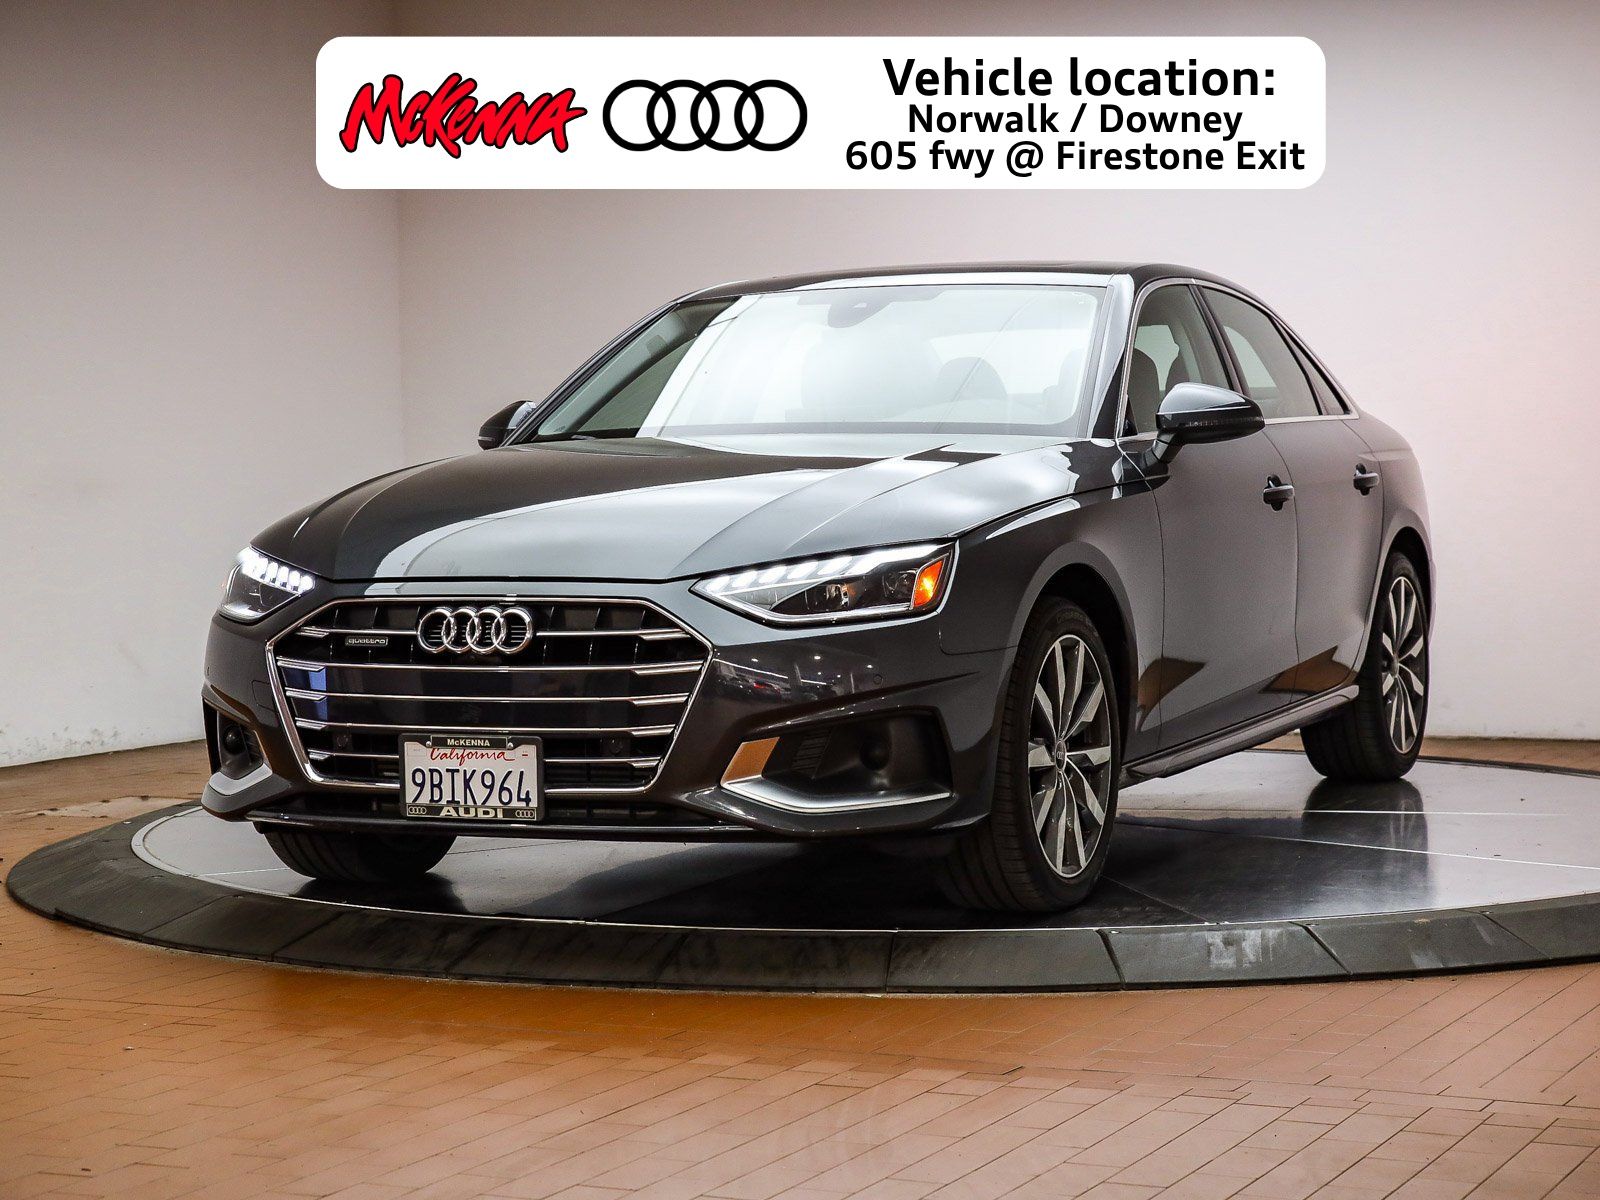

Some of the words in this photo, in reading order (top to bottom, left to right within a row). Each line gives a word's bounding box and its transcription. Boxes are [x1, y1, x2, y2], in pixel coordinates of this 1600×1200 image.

[447, 738, 490, 747] McKENNA
[430, 748, 515, 766] California
[411, 768, 532, 807] 9BIK964
[439, 806, 504, 818] AUDI
